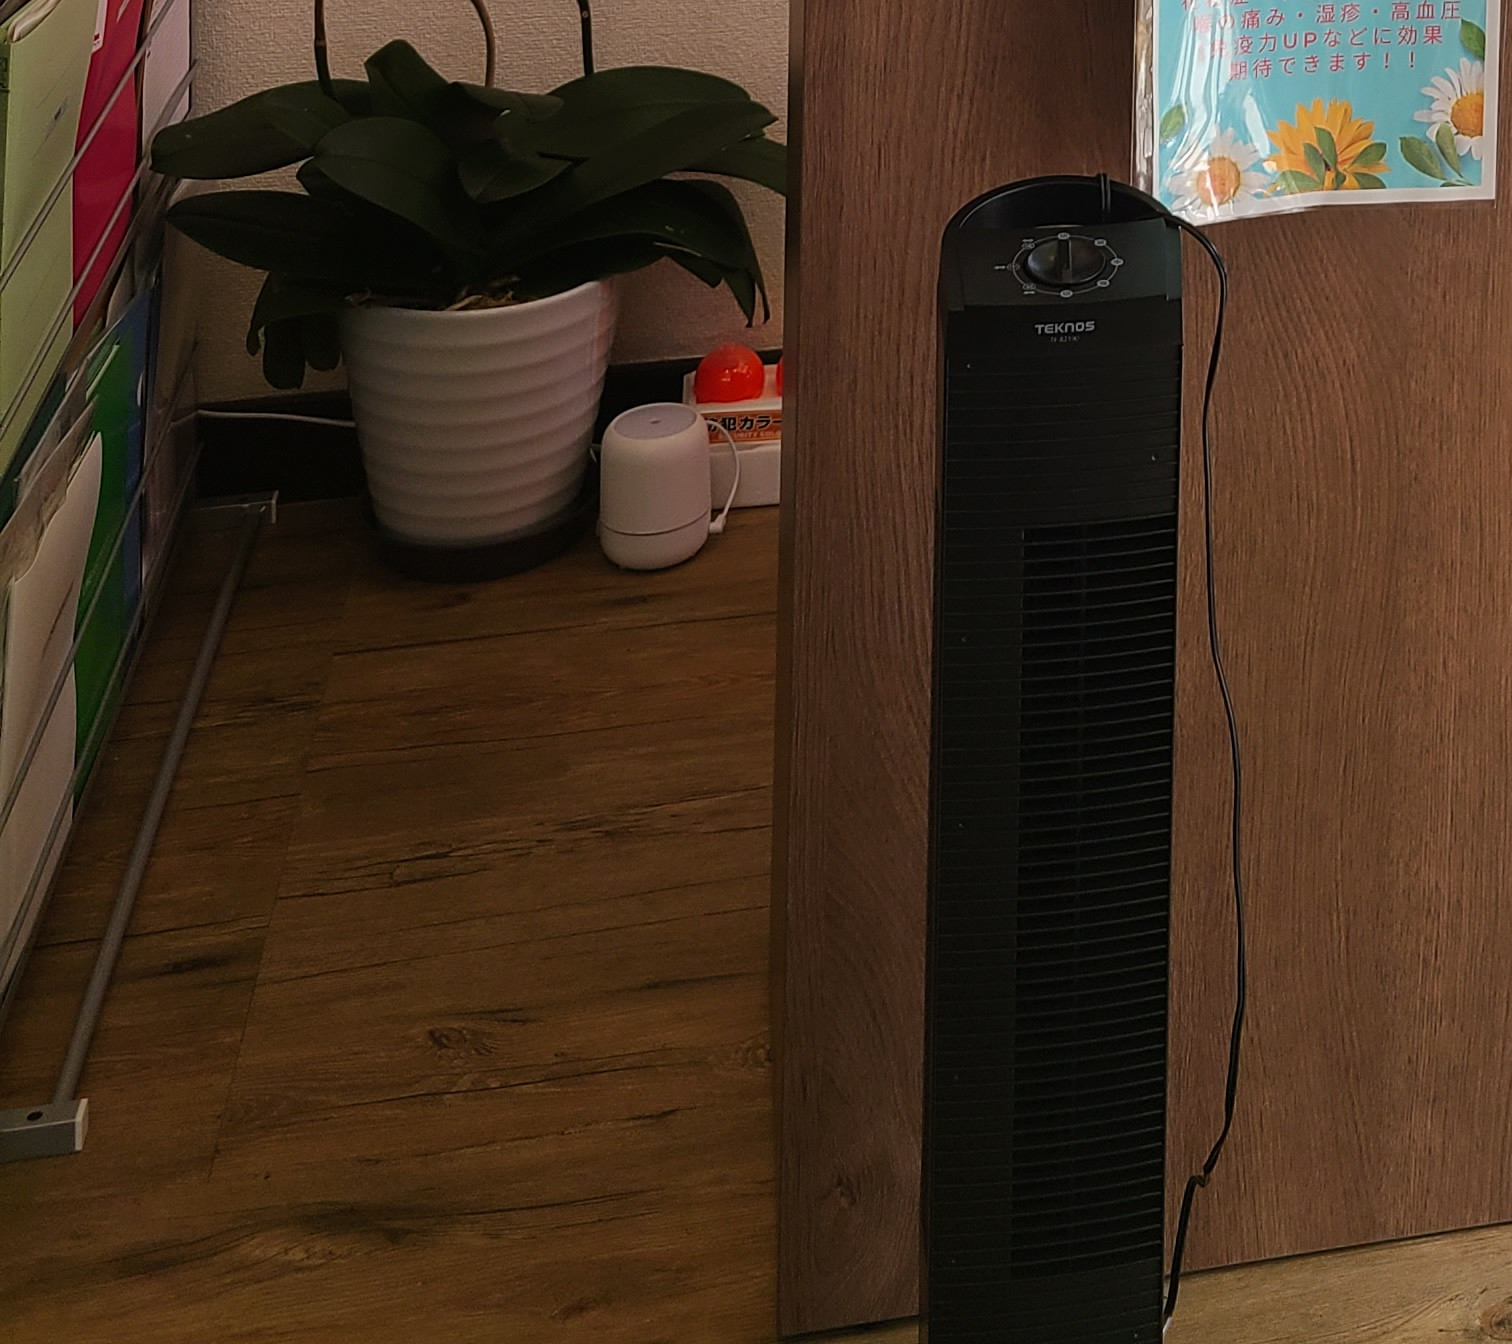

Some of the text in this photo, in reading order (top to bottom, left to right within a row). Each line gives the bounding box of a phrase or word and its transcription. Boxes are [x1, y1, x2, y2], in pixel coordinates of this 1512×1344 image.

[1229, 50, 1416, 81] 期待できます！！
[1034, 321, 1096, 335] TEKNOS
